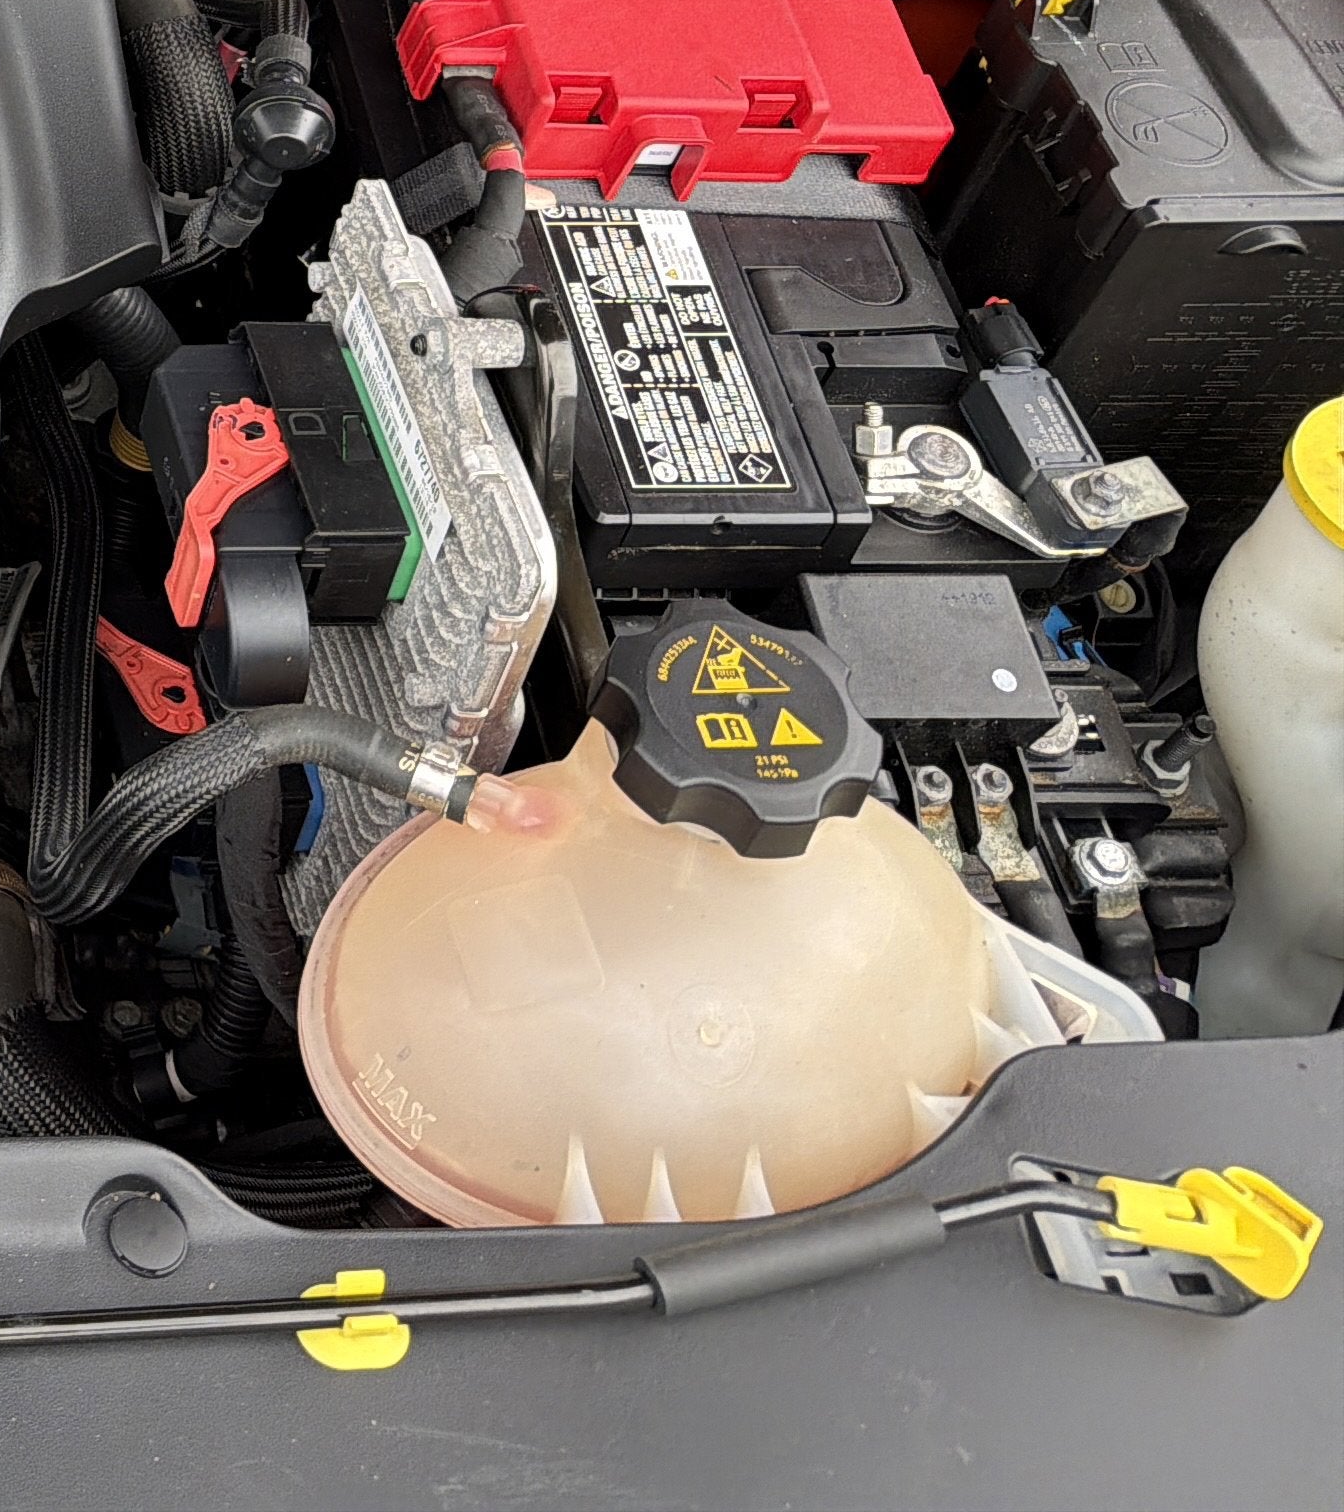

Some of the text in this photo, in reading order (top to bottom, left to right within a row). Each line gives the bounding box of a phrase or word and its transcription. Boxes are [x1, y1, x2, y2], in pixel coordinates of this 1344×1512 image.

[670, 292, 691, 325] DO NOT
[692, 293, 712, 323] NE PAS
[567, 282, 623, 404] DANGER/POISON
[413, 436, 440, 505] 6727740
[770, 754, 789, 765] PSI
[358, 1051, 437, 1141] MAX
